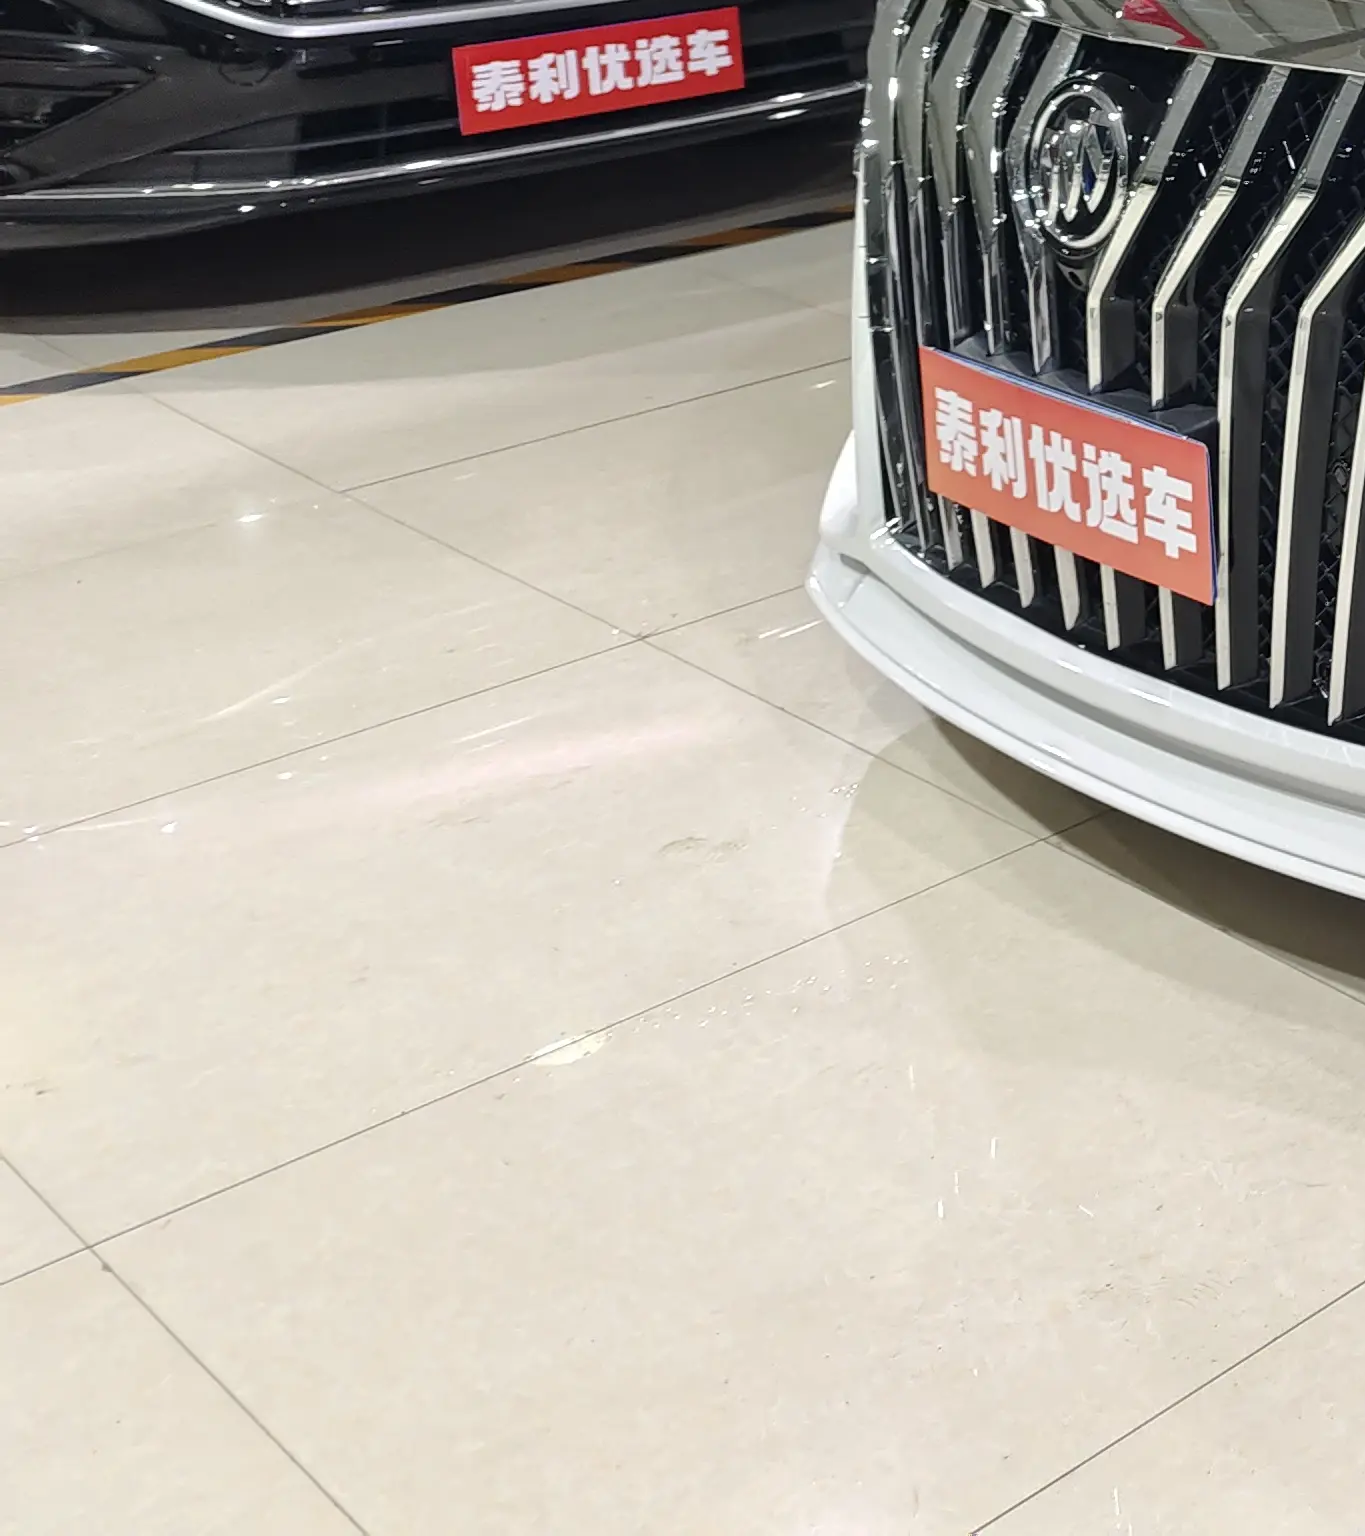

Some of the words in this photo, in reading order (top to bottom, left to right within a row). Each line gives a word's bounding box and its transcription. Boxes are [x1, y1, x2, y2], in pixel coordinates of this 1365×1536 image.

[471, 28, 733, 112] 泰利优选车
[933, 386, 1198, 559] 泰利优选车
